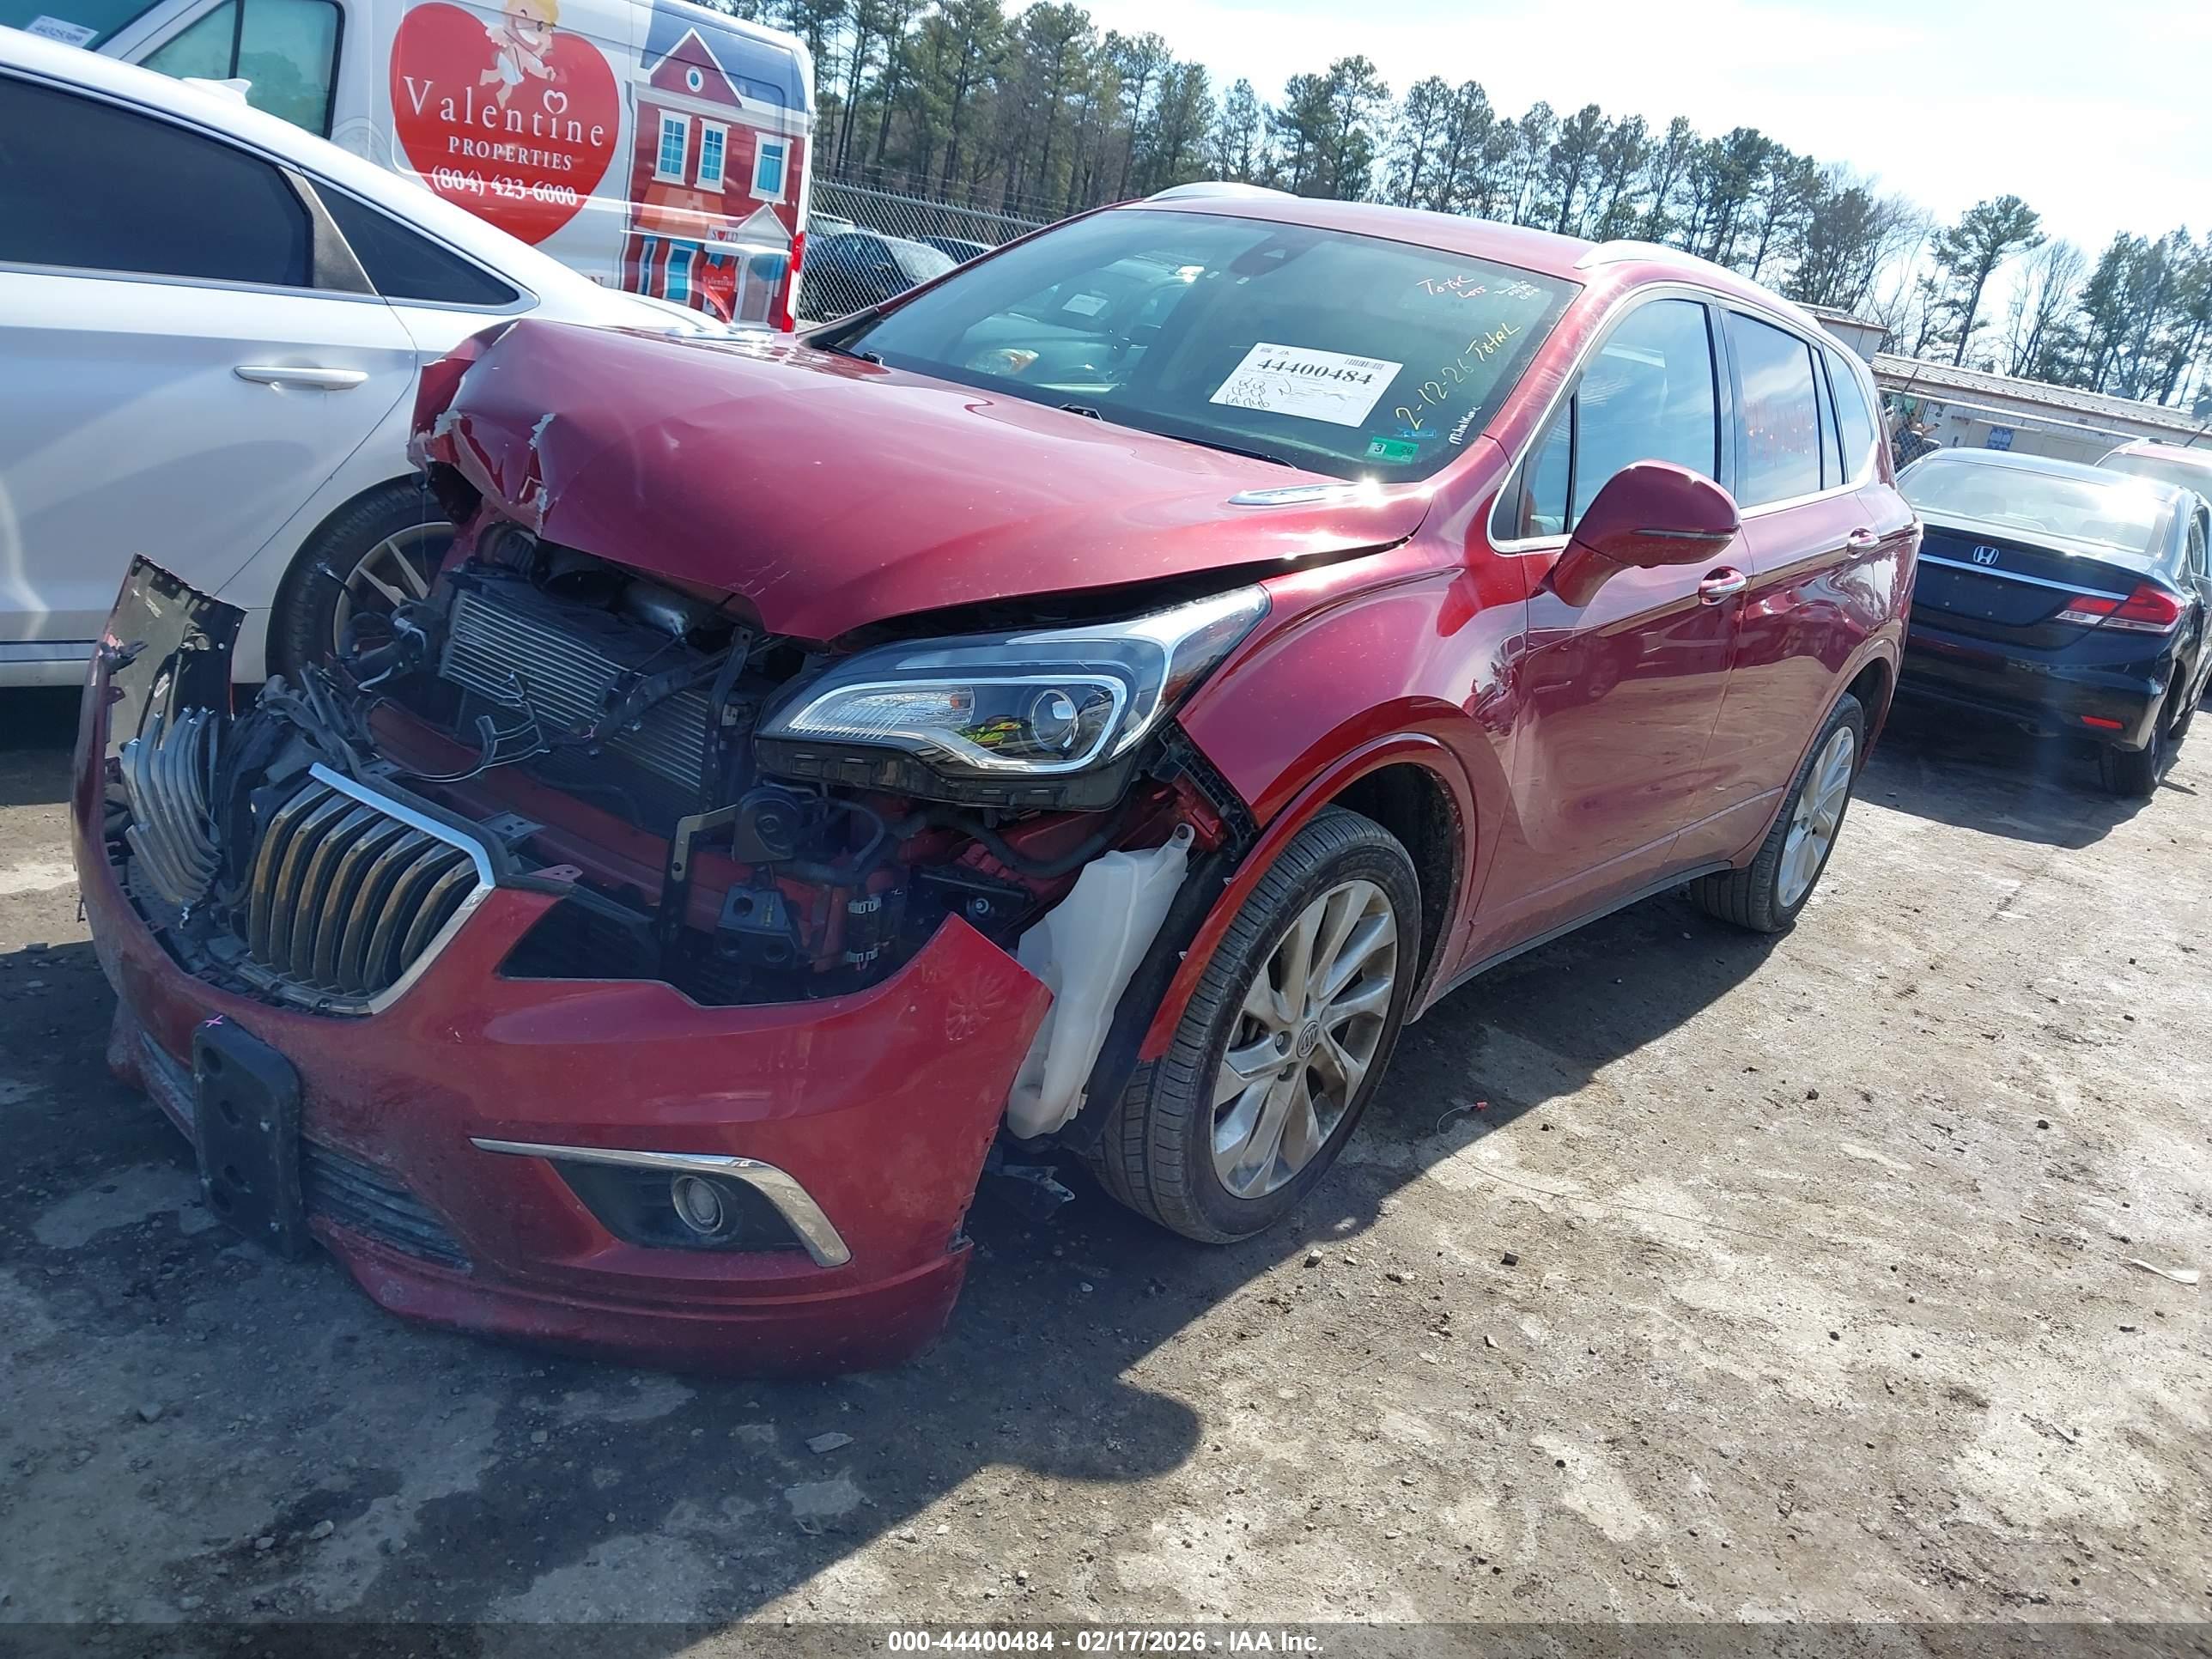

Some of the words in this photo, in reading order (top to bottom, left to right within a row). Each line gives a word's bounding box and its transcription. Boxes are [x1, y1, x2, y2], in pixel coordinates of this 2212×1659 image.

[403, 76, 605, 147] Valentine
[447, 136, 573, 172] PROPERTIES
[431, 164, 485, 197] (804)
[490, 173, 578, 206] 423-6000
[1257, 358, 1376, 386] 44400484
[1374, 444, 1383, 453] 3
